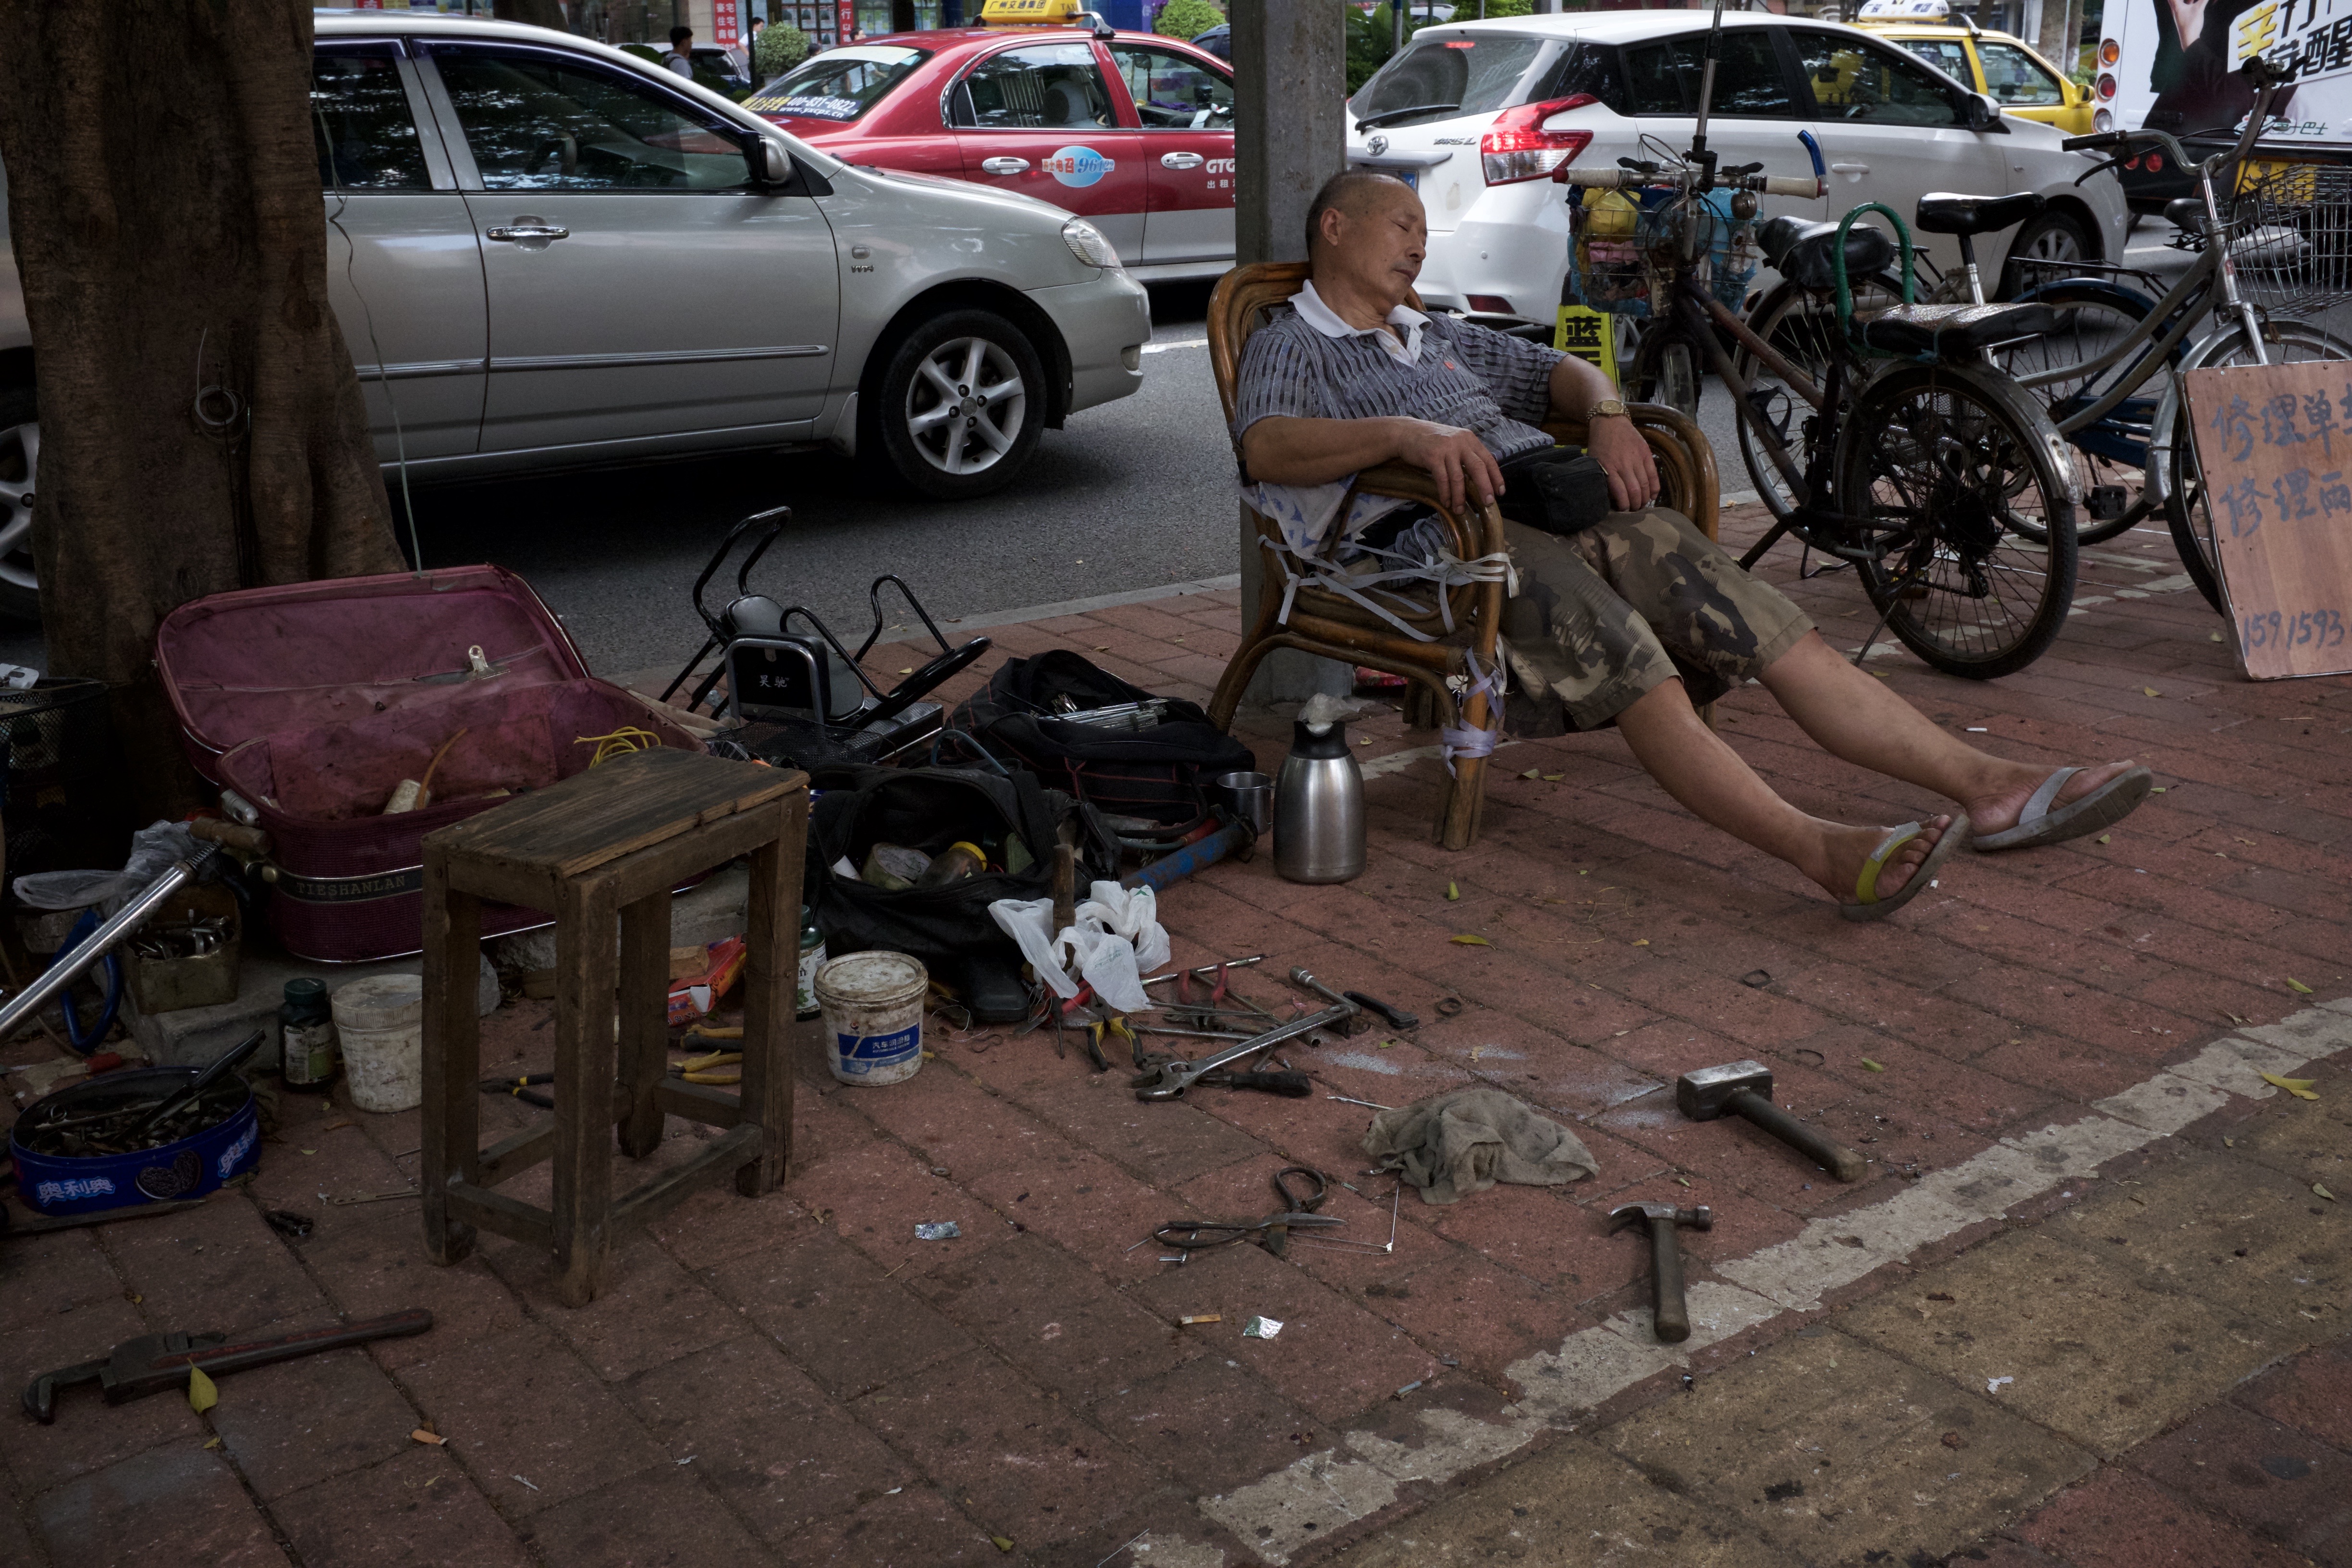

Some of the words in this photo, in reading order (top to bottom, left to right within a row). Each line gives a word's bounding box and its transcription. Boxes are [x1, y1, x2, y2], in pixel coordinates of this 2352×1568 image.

[989, 0, 1047, 9] 广州交通集团
[717, 16, 736, 26] 住宅
[779, 106, 844, 118] www.yxcps.cn
[786, 97, 857, 112] 400-831-0822
[1077, 157, 1114, 173] 96122
[1565, 316, 1602, 367] 蓝
[296, 875, 405, 896] TIESHANLAN
[38, 1178, 114, 1204] 奥利奥
